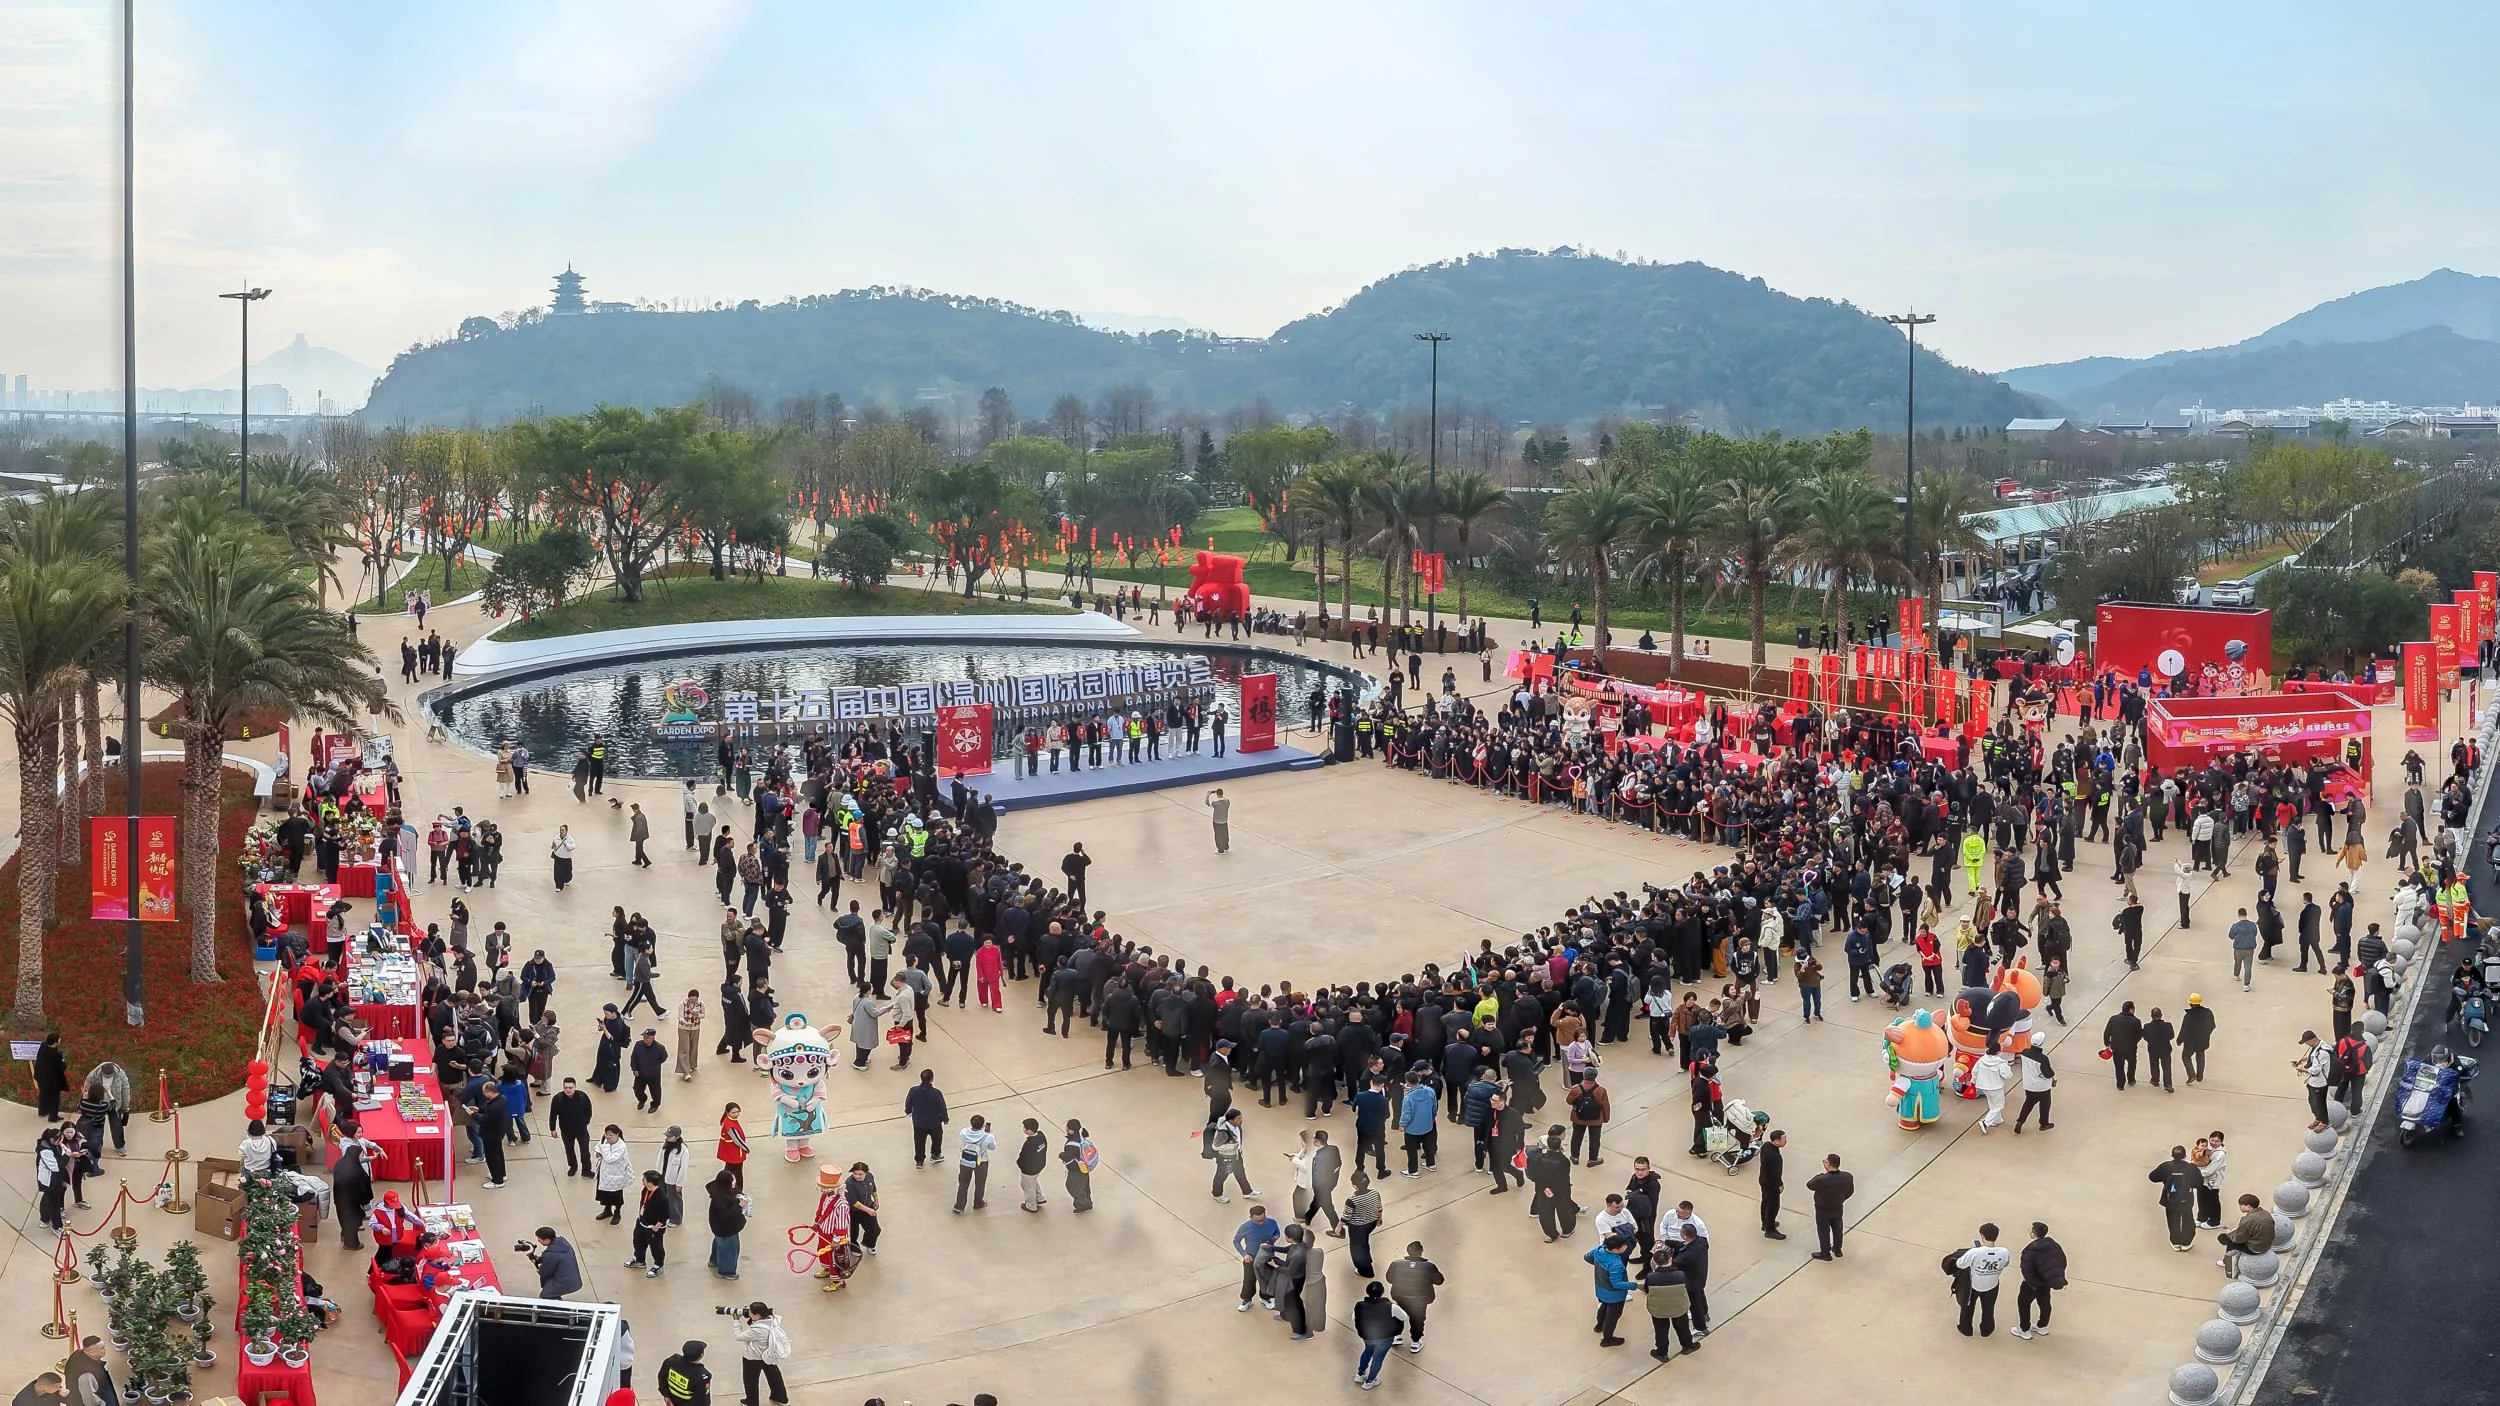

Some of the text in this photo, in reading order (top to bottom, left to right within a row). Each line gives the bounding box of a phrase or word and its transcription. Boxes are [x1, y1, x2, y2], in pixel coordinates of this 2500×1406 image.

[728, 724, 760, 737] THE
[775, 722, 805, 735] 15th
[997, 699, 1112, 721] INTERNATIONAL
[1125, 690, 1178, 706] GARDEN
[1188, 686, 1216, 697] EXPO
[1248, 695, 1273, 724] 福
[657, 726, 716, 735] GARDEN EXPO
[145, 851, 168, 863] 新春
